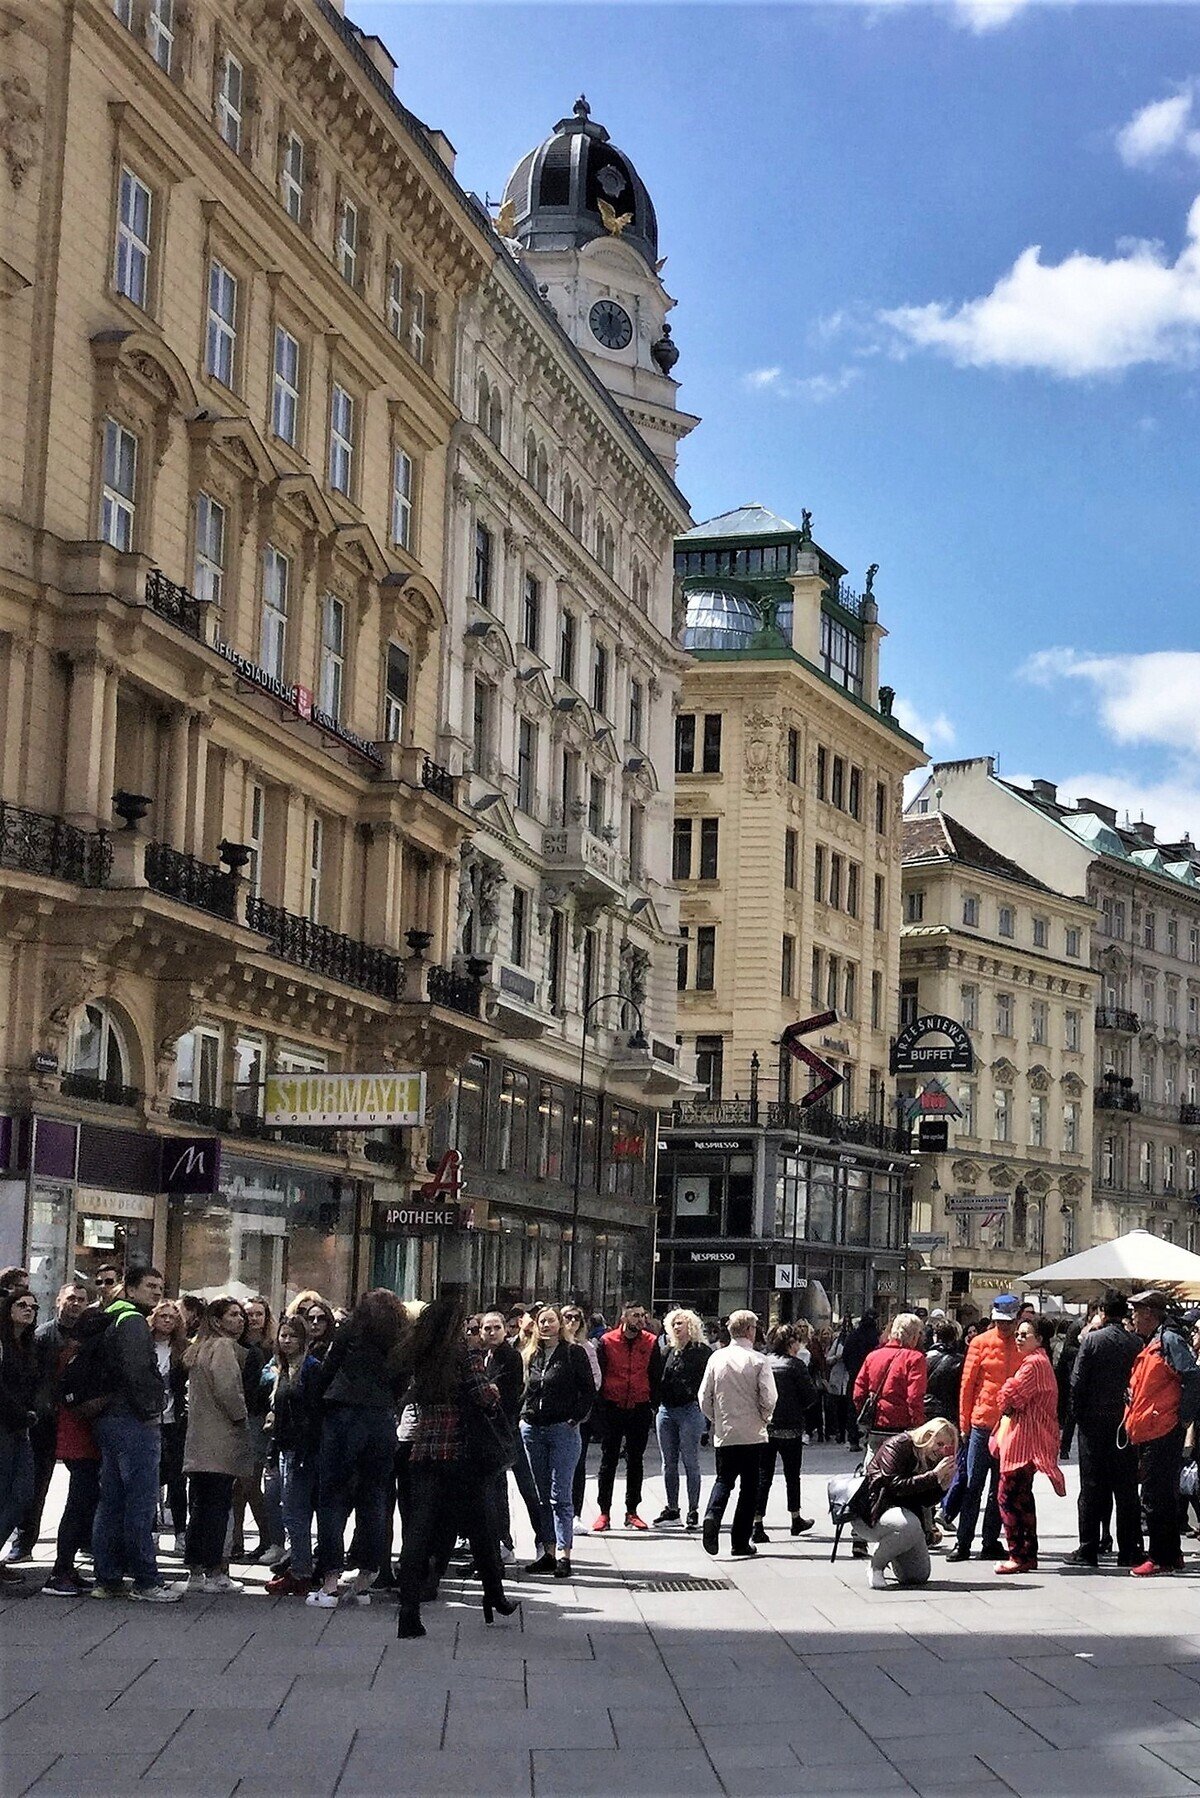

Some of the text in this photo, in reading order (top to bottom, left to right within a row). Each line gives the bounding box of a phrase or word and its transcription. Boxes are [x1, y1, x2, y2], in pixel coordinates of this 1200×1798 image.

[911, 1049, 955, 1060] BUFFET
[275, 1079, 410, 1113] STURMAYR
[275, 1114, 408, 1122] COIFFEURE
[694, 1141, 739, 1149] NESPRESSO
[386, 1209, 454, 1225] APOTHEKE
[691, 1252, 735, 1261] NESPRESSO
